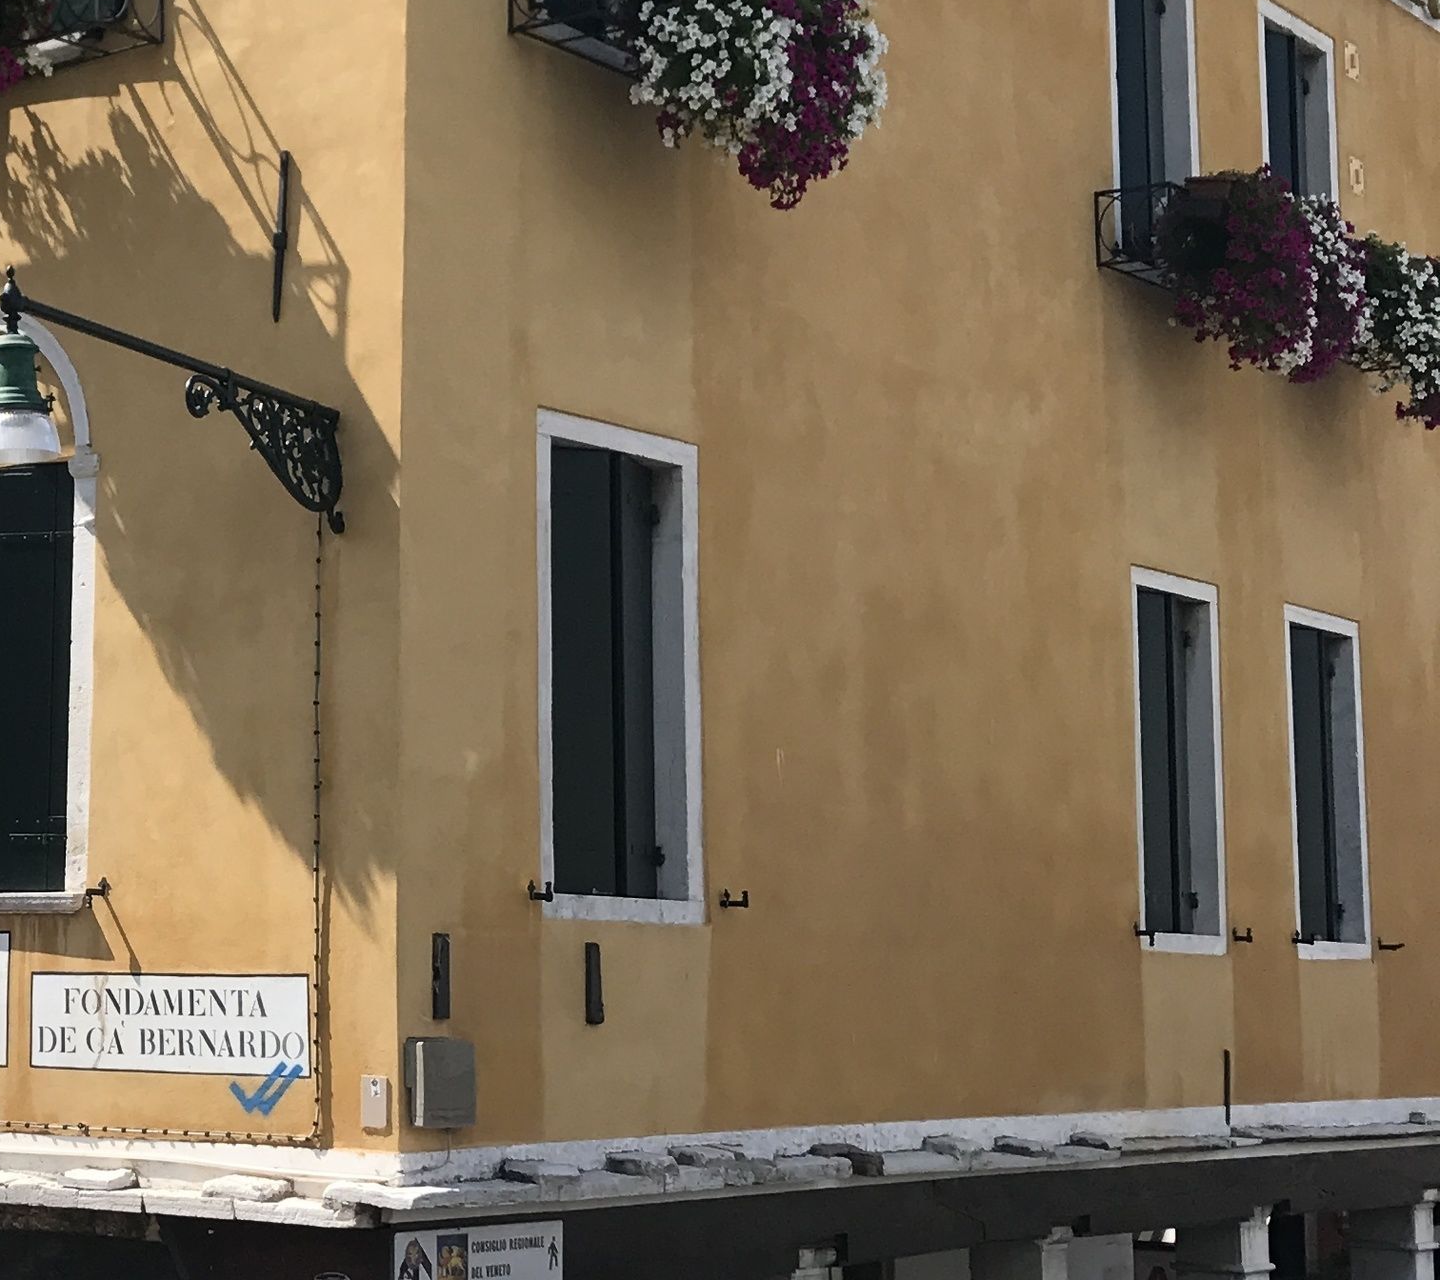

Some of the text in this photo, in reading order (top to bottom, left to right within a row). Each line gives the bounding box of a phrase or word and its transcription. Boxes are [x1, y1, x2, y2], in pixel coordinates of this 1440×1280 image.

[63, 987, 268, 1018] FONDAMENTA
[37, 1025, 77, 1054] DE
[139, 1028, 305, 1060] BERNARDO
[471, 1235, 545, 1254] CONSIGLIO REGIONALE
[471, 1263, 512, 1280] DEL VENETO
